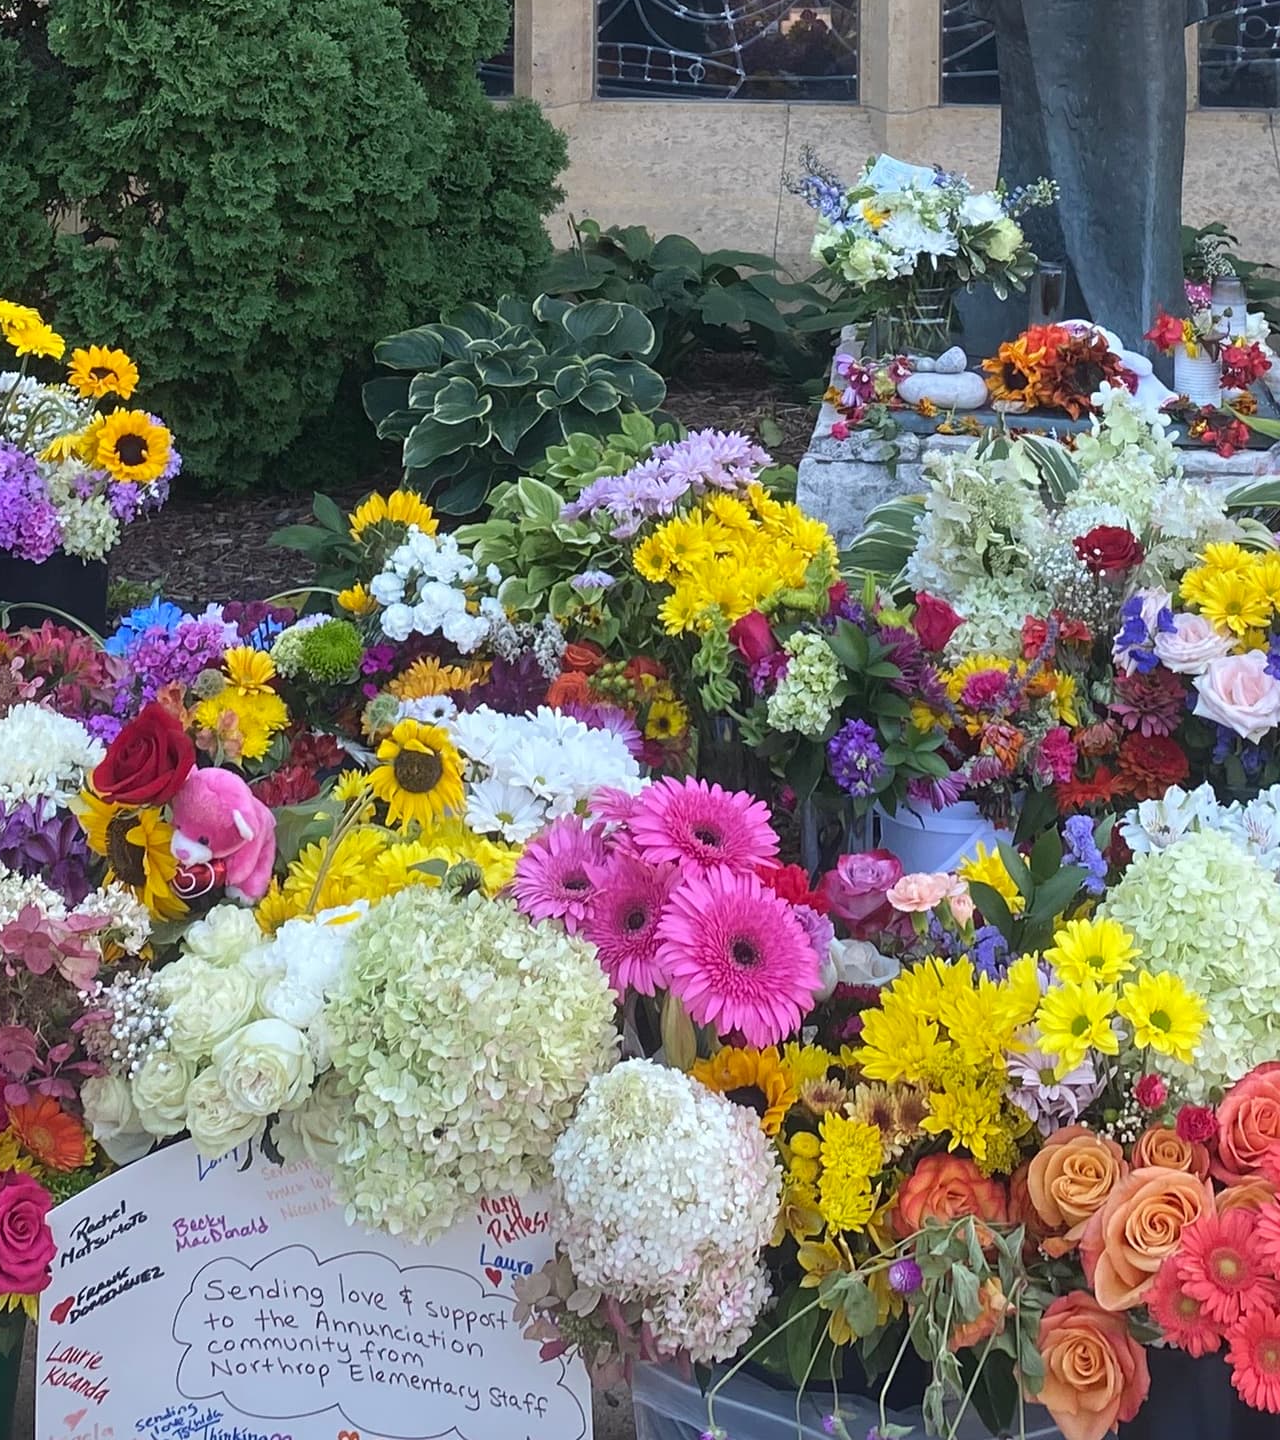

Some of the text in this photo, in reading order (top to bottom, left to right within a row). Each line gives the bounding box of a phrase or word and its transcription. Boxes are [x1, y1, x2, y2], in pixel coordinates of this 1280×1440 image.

[172, 1214, 227, 1237] Becky
[175, 1215, 269, 1253] MacDonald
[480, 1242, 534, 1275] Laura
[76, 1265, 130, 1306] FRANK
[203, 1278, 325, 1308] Sending
[338, 1273, 388, 1311] love
[425, 1299, 509, 1331] support
[203, 1309, 486, 1360] to the Annunciation
[207, 1338, 425, 1367] community from
[45, 1340, 105, 1370] Laurie
[41, 1365, 111, 1406] Kocanda
[211, 1360, 550, 1418] Northrop Elementary Staff
